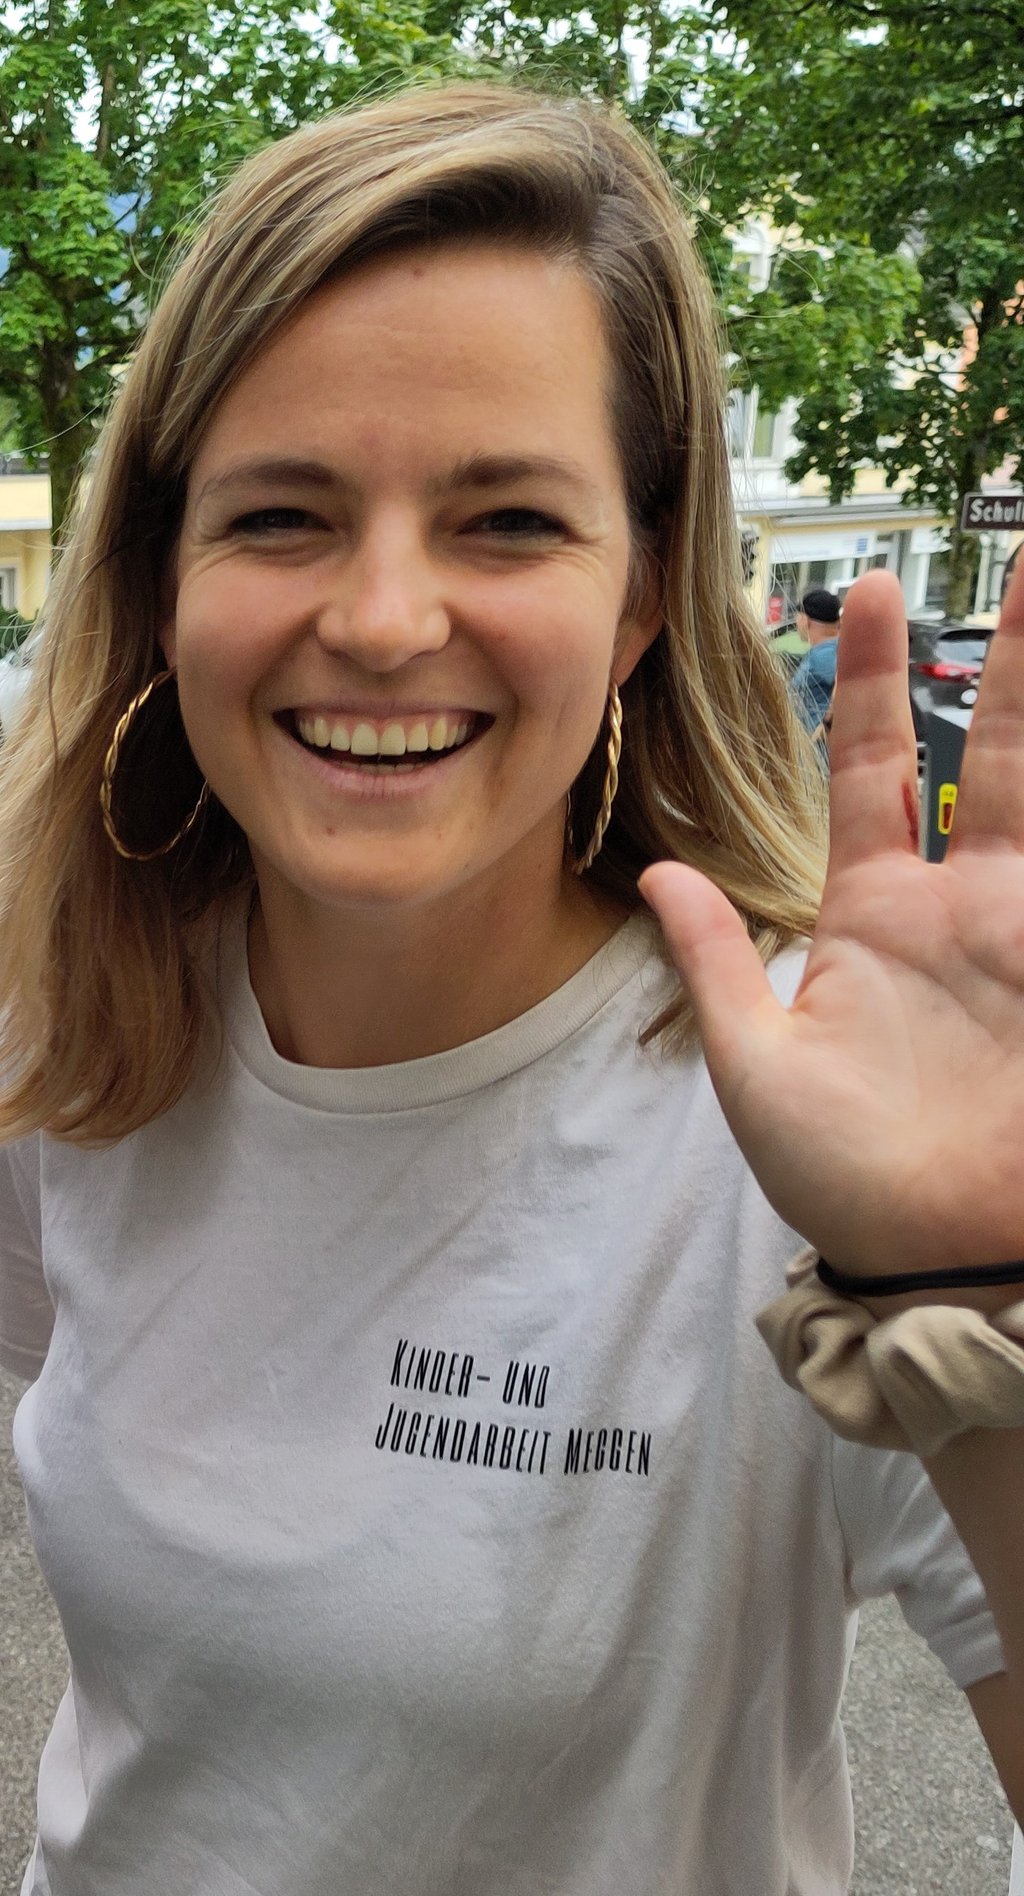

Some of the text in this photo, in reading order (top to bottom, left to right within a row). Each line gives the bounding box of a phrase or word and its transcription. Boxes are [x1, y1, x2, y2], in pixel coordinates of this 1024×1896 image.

[970, 498, 1024, 522] Schul
[390, 1339, 550, 1408] KINDER- UND
[375, 1402, 652, 1476] JUGENDARBEIT MEGGEN
